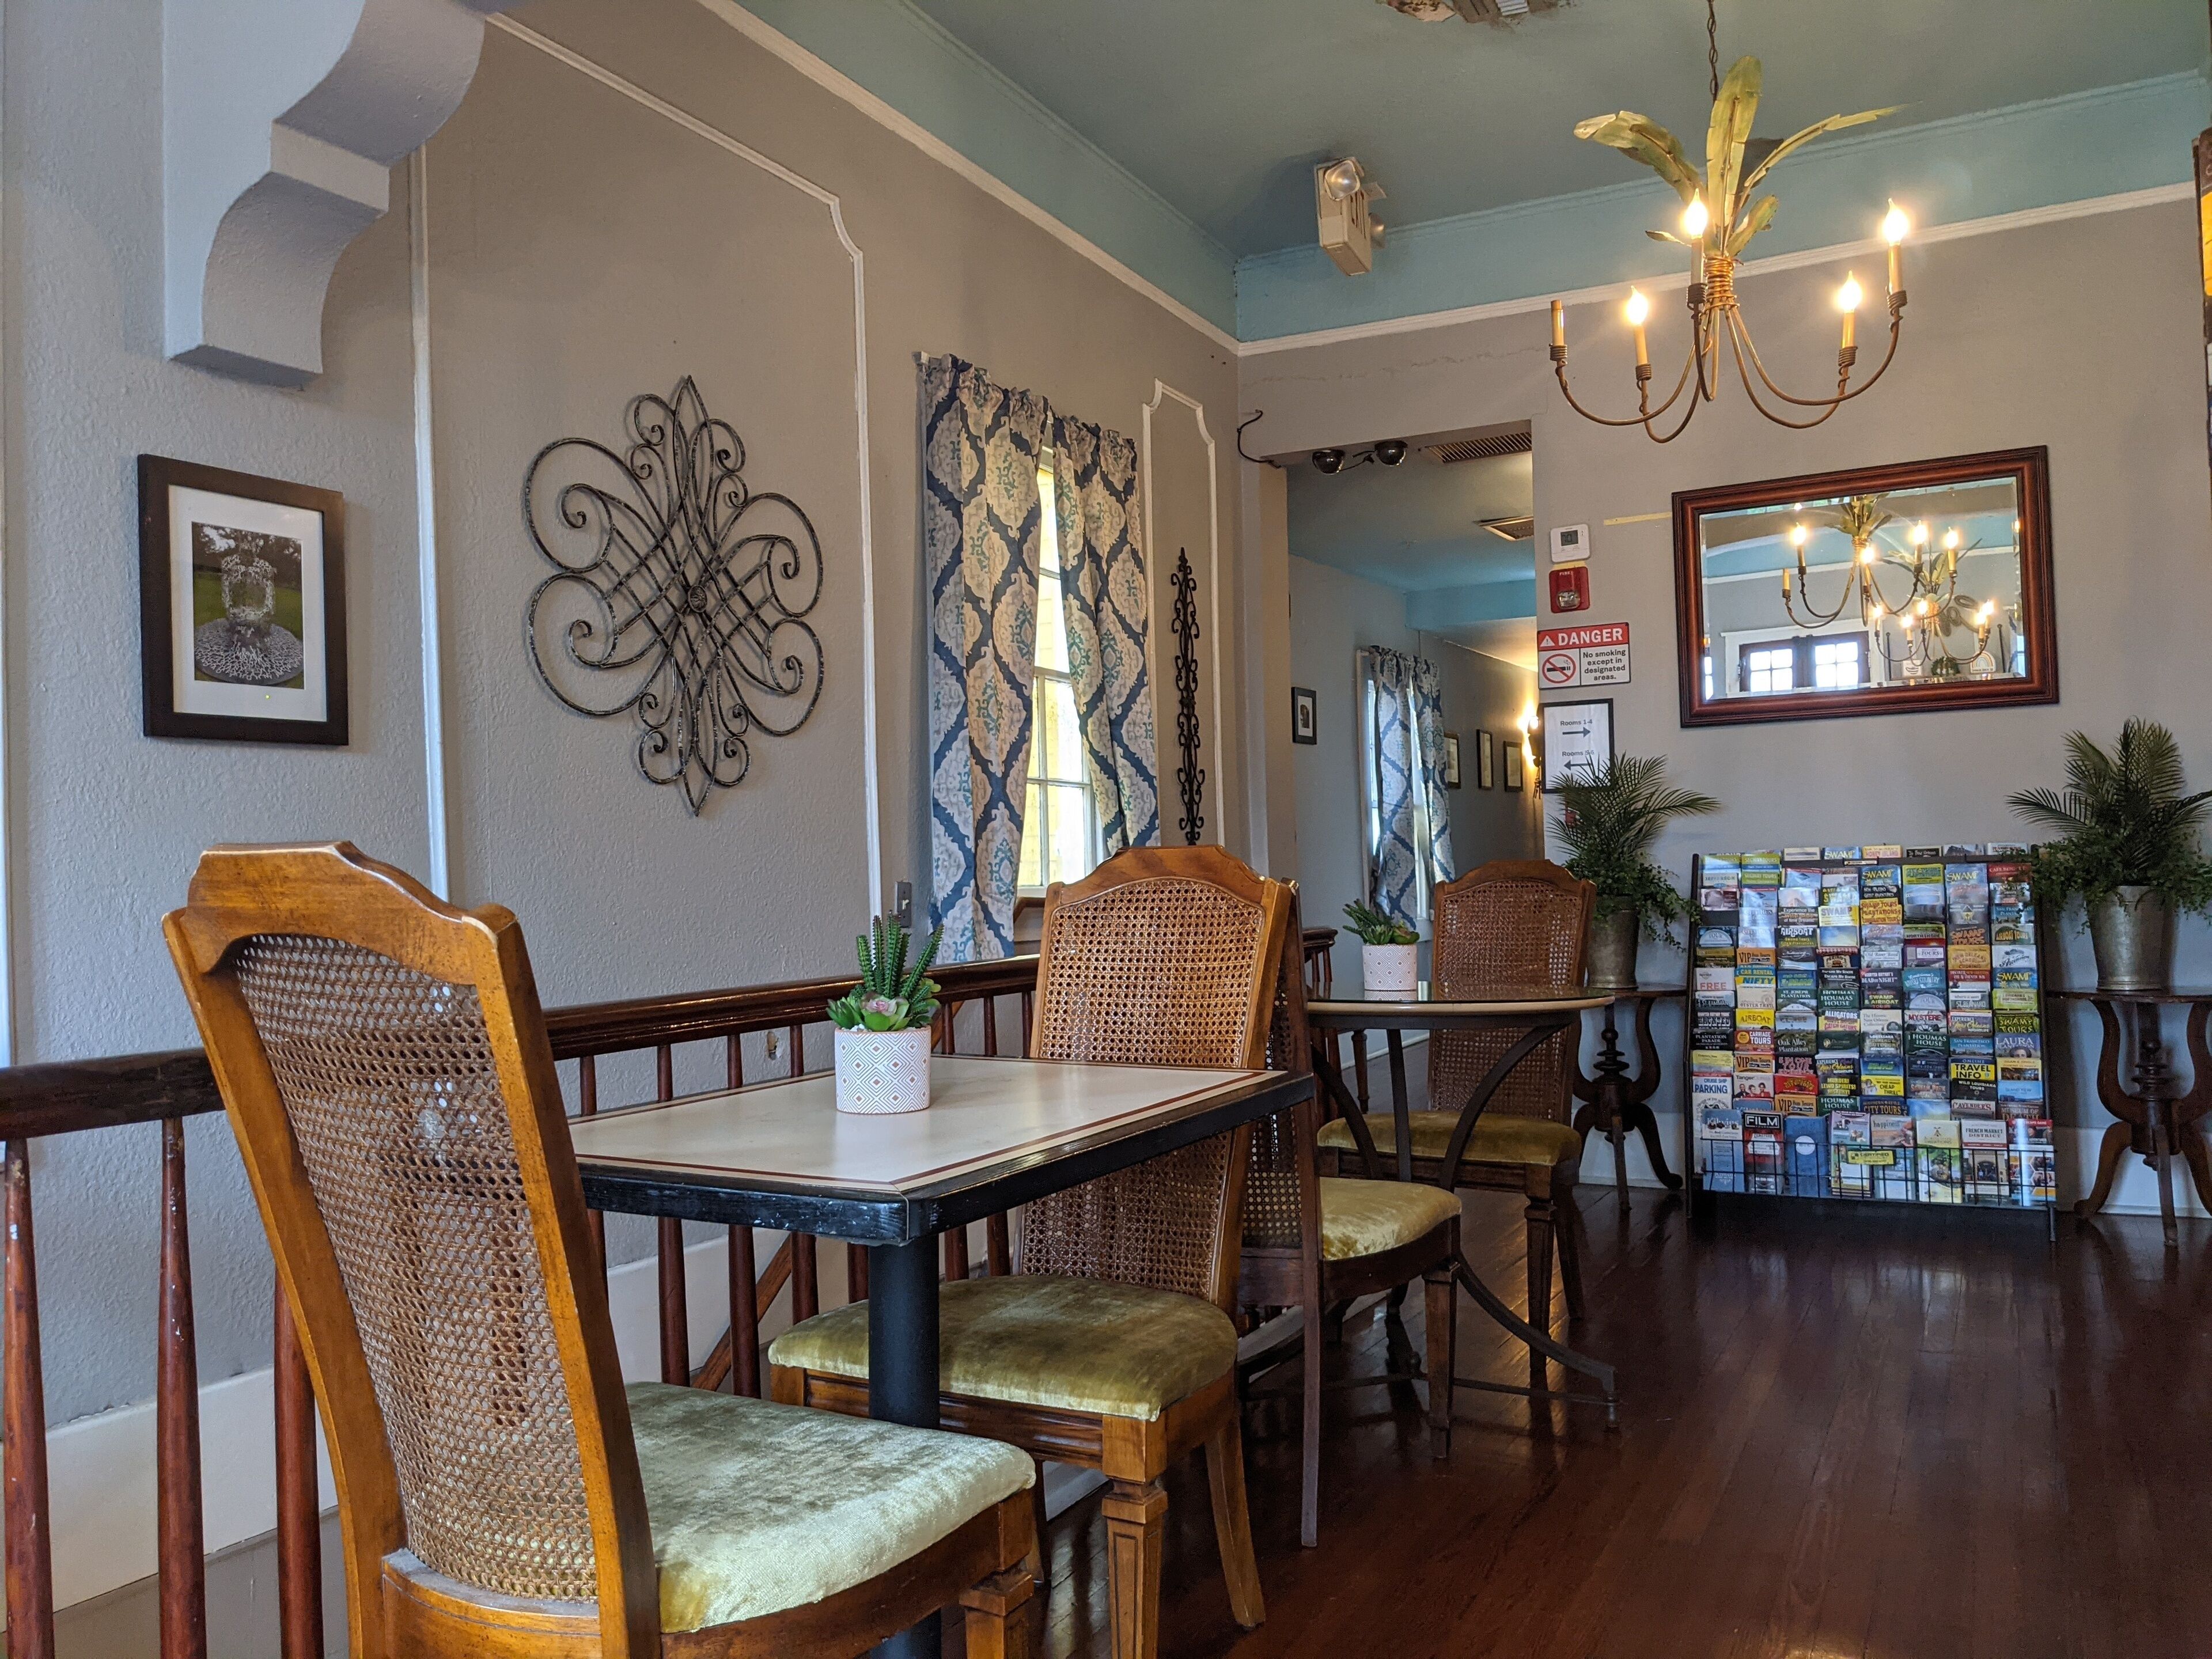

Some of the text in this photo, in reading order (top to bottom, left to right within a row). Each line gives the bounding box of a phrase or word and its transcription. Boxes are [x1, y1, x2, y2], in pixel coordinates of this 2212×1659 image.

[1558, 628, 1623, 646] DANGER
[1595, 649, 1626, 657] smoking
[1584, 665, 1626, 673] designated
[1824, 850, 1855, 859] SWAMP
[1861, 869, 1895, 880] SWAMP
[1946, 871, 1980, 882] SWAMP
[1738, 952, 1751, 963] VIP
[1996, 972, 2031, 981] SWAMP
[1700, 982, 1727, 990] FREE
[1741, 1015, 1771, 1024] AIRBOAT
[1824, 1010, 1858, 1019] ALLIGATORS
[1792, 1038, 1807, 1047] Alley
[1736, 1056, 1750, 1068] VIP
[1955, 1064, 1991, 1072] TRAVEL
[1695, 1084, 1728, 1094] PARKING
[1778, 1099, 1792, 1112] VIP
[1864, 1106, 1879, 1114] CITY
[1880, 1105, 1902, 1115] TOURS
[1952, 1101, 1991, 1111] CAVENDER'S
[1746, 1116, 1778, 1126] FILM
